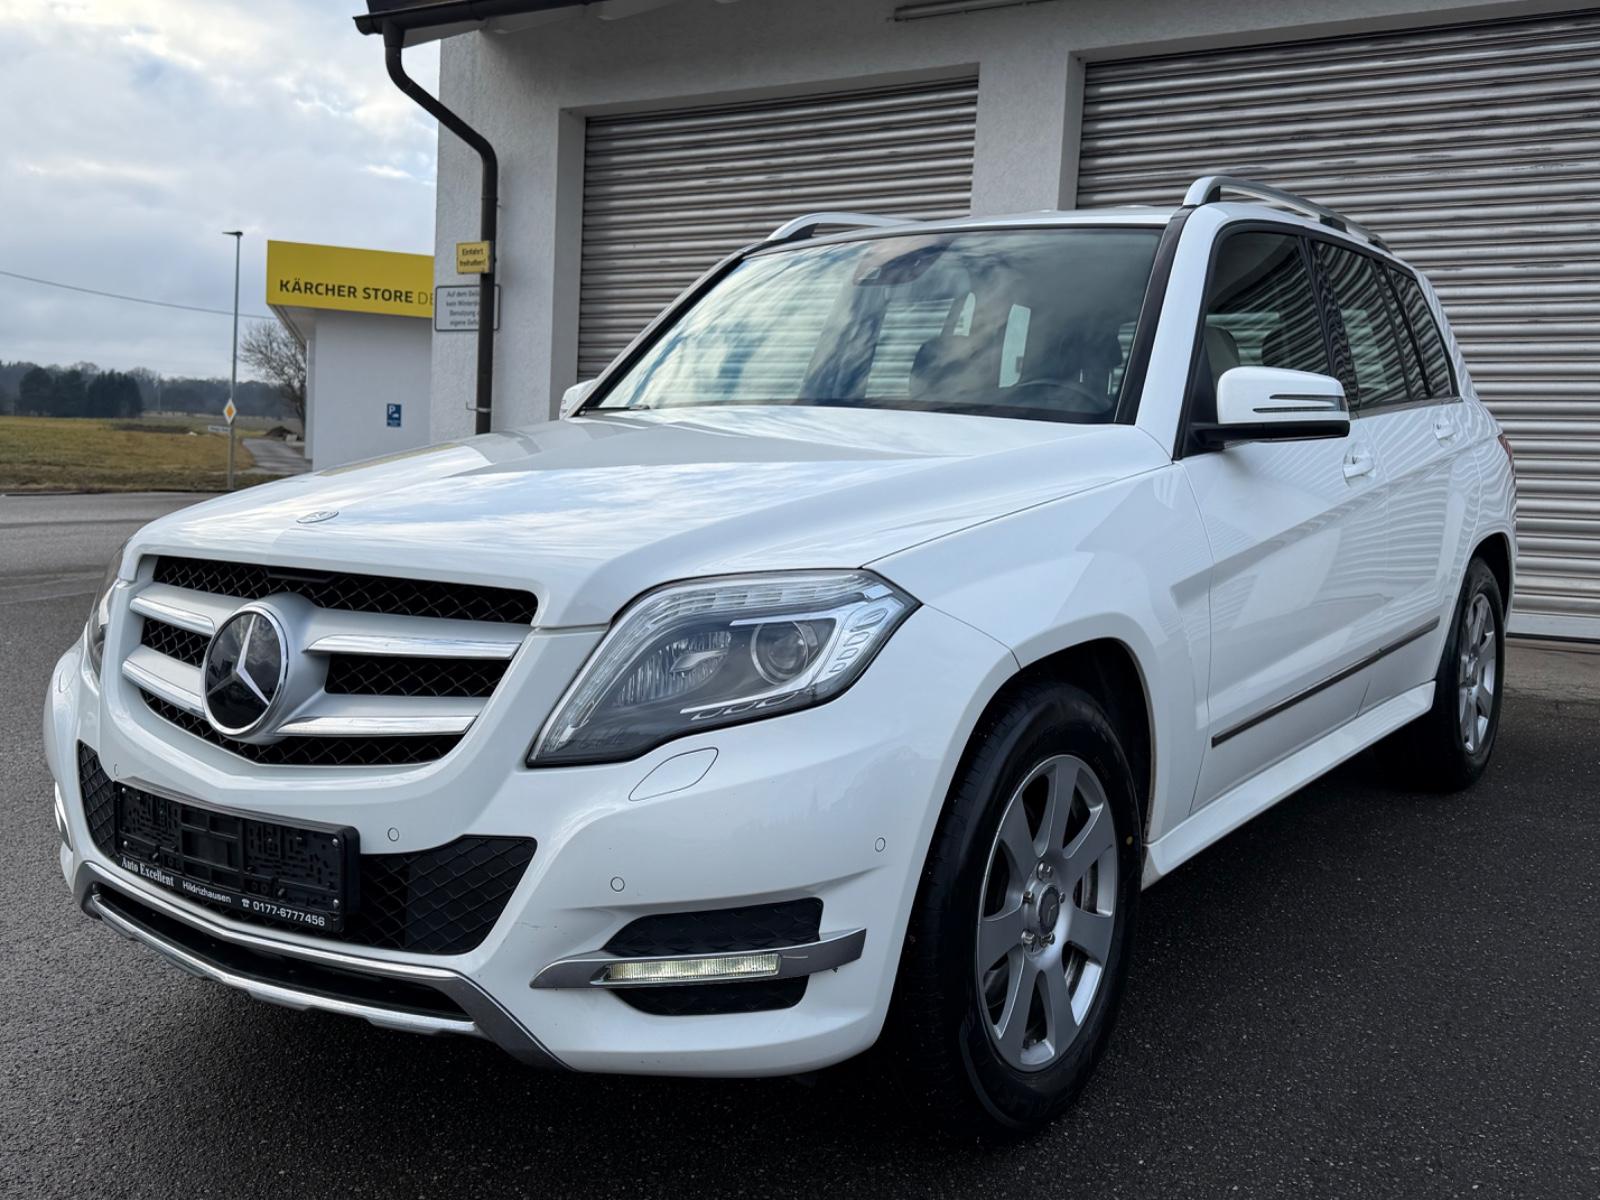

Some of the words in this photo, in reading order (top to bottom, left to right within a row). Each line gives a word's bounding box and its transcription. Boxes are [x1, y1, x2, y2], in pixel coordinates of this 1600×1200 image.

[279, 278, 357, 298] KÄRCHER
[362, 287, 413, 304] STORE
[121, 857, 139, 873] Auto
[139, 863, 175, 888] Excellent
[182, 880, 232, 904] Hildrizhausen
[252, 900, 326, 927] 0177-6777456
